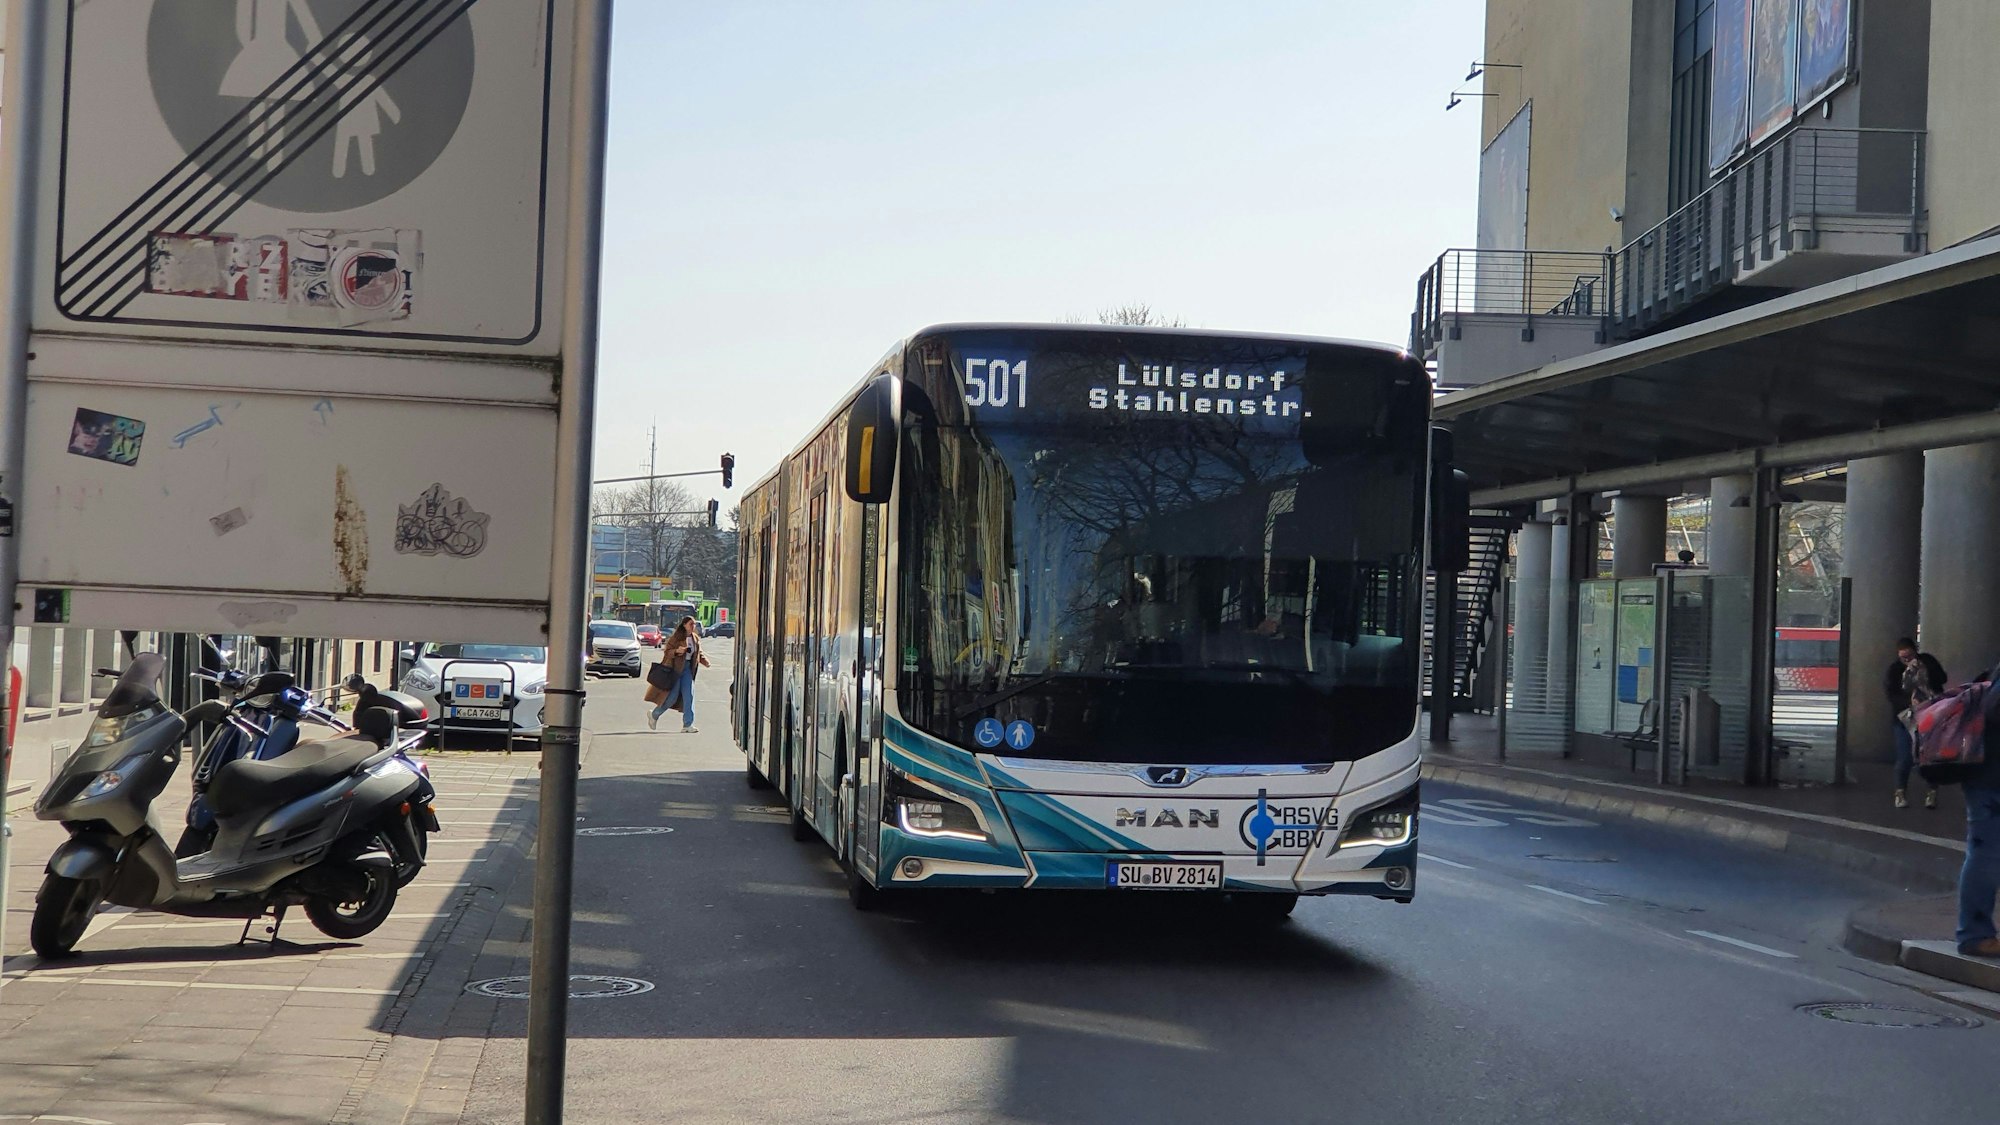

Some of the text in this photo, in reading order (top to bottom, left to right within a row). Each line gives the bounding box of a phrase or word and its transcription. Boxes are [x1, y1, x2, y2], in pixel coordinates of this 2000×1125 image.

[965, 358, 1027, 408] 501
[1117, 364, 1285, 391] Lülsdorf
[1089, 388, 1312, 418] Stahlenstr.
[467, 709, 478, 717] CA
[479, 709, 500, 718] 7483
[1116, 807, 1219, 828] MAN
[1283, 807, 1338, 825] RSVG
[1283, 830, 1325, 848] BBV
[1120, 866, 1142, 884] SU
[1151, 867, 1173, 884] BV
[1177, 867, 1217, 885] 2814
